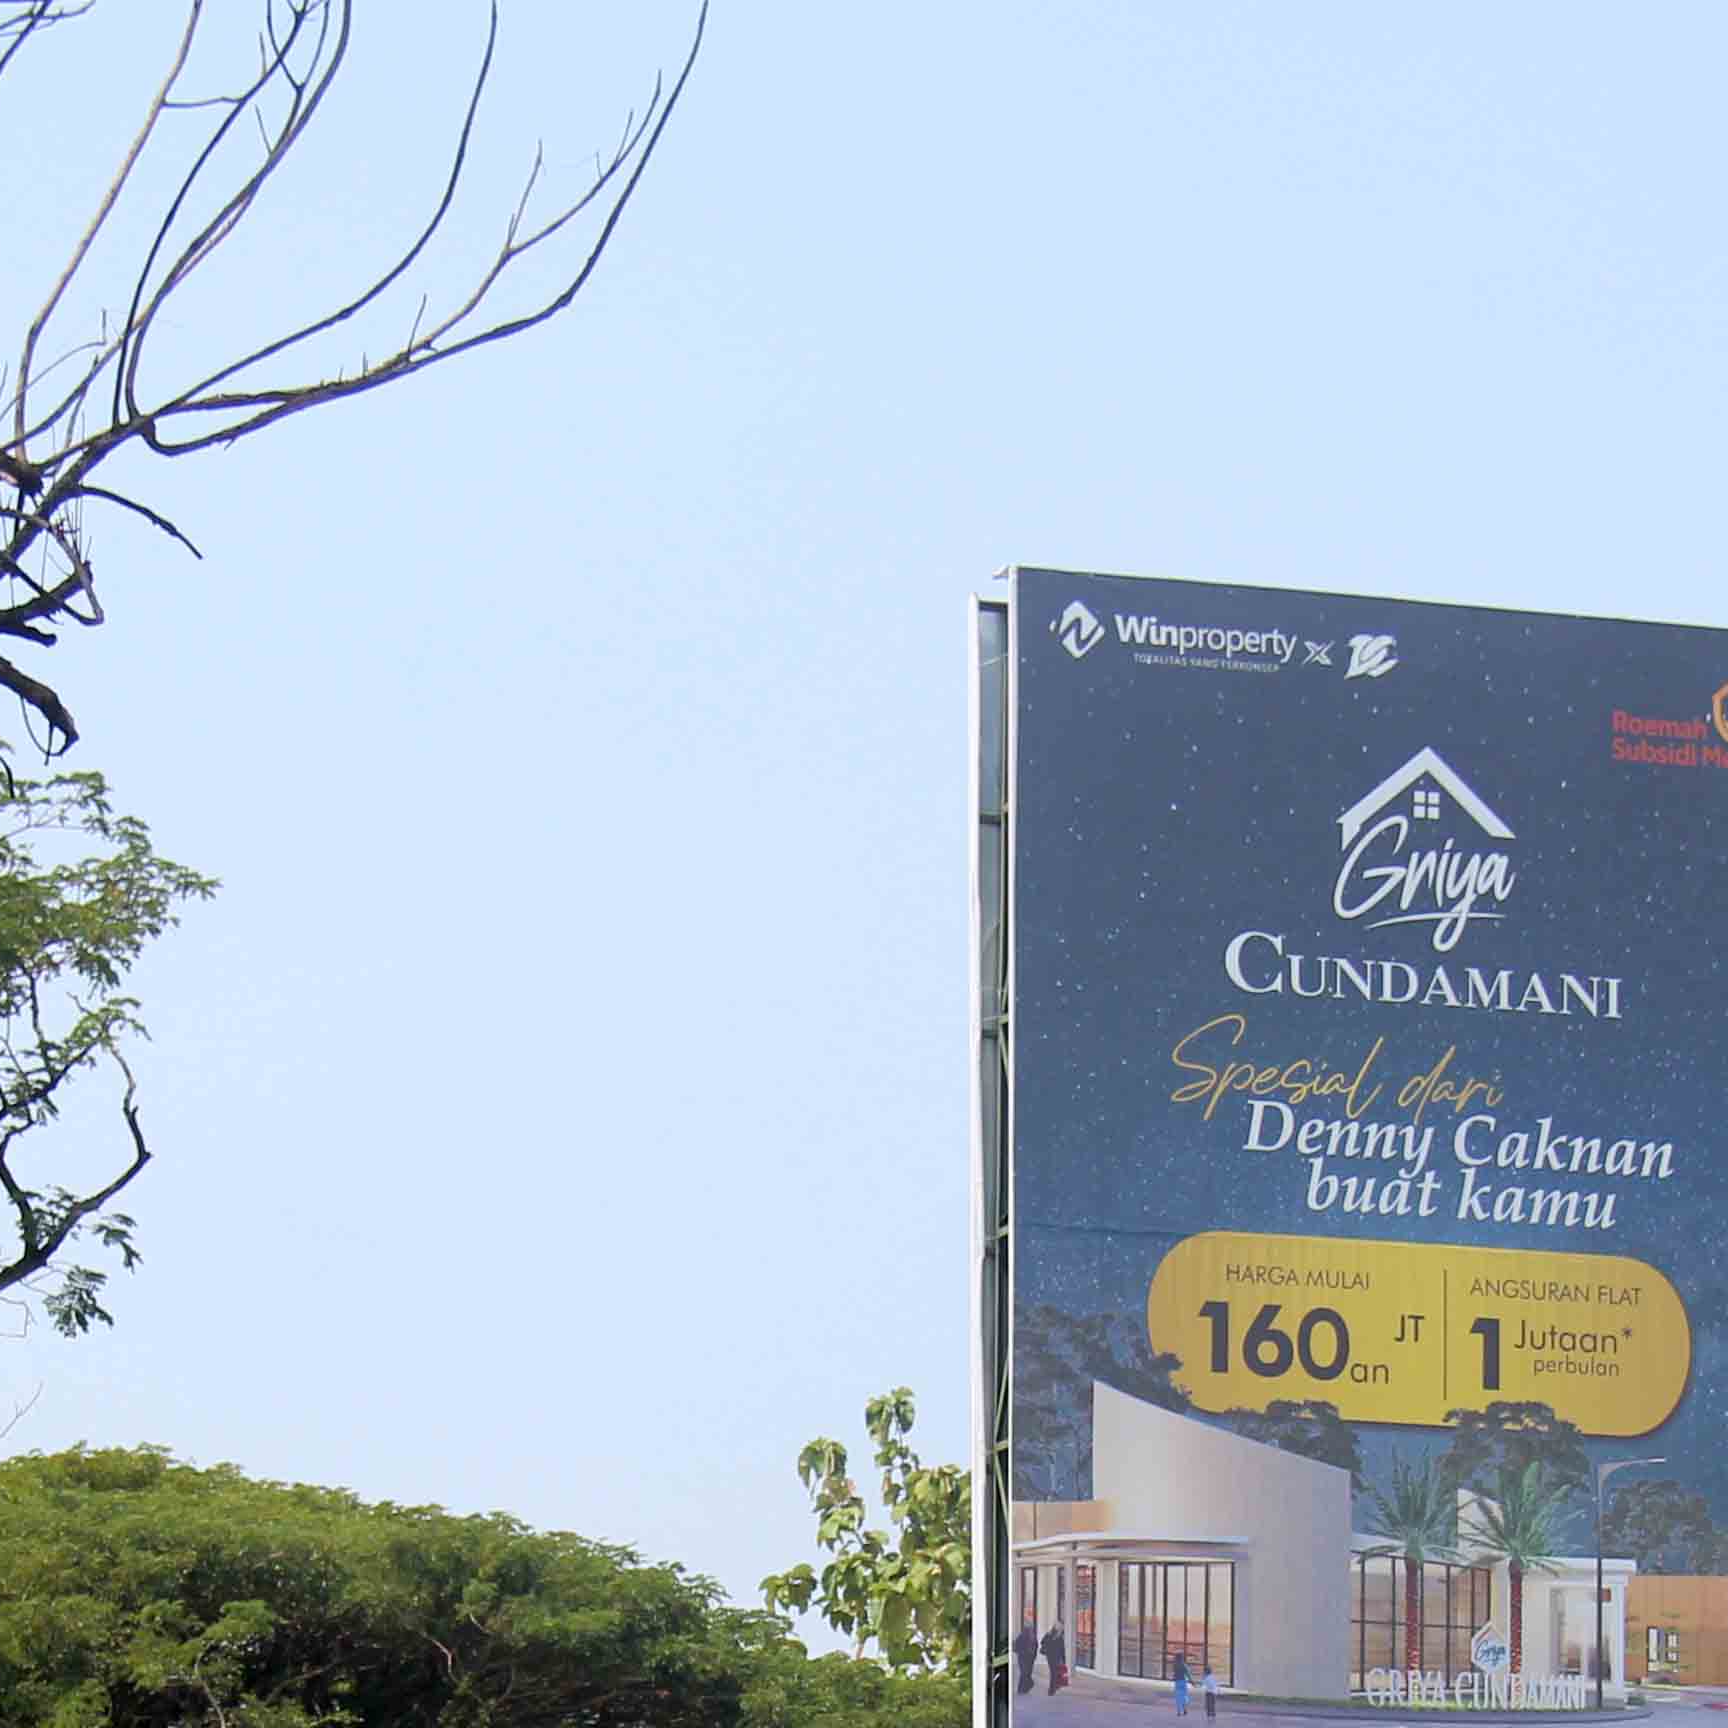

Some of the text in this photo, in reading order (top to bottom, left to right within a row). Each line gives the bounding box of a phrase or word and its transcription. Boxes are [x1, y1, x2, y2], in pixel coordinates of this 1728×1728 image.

[1114, 612, 1298, 664] Winproperty
[1611, 708, 1707, 740] Roemah
[1611, 736, 1697, 766] Subsidi
[1332, 813, 1518, 952] Griya
[1224, 930, 1623, 1020] CUNDAMANI
[1171, 1013, 1504, 1125] Spesial dari
[1242, 1099, 1674, 1179] Denny Caknan
[1305, 1157, 1618, 1230] buat kamu
[1225, 1263, 1370, 1291] HARGA MULAI
[1470, 1278, 1642, 1306] ANGSURAN FLAT
[1393, 1313, 1426, 1344] JT
[1469, 1317, 1501, 1392] 1
[1532, 1356, 1621, 1378] perbulan
